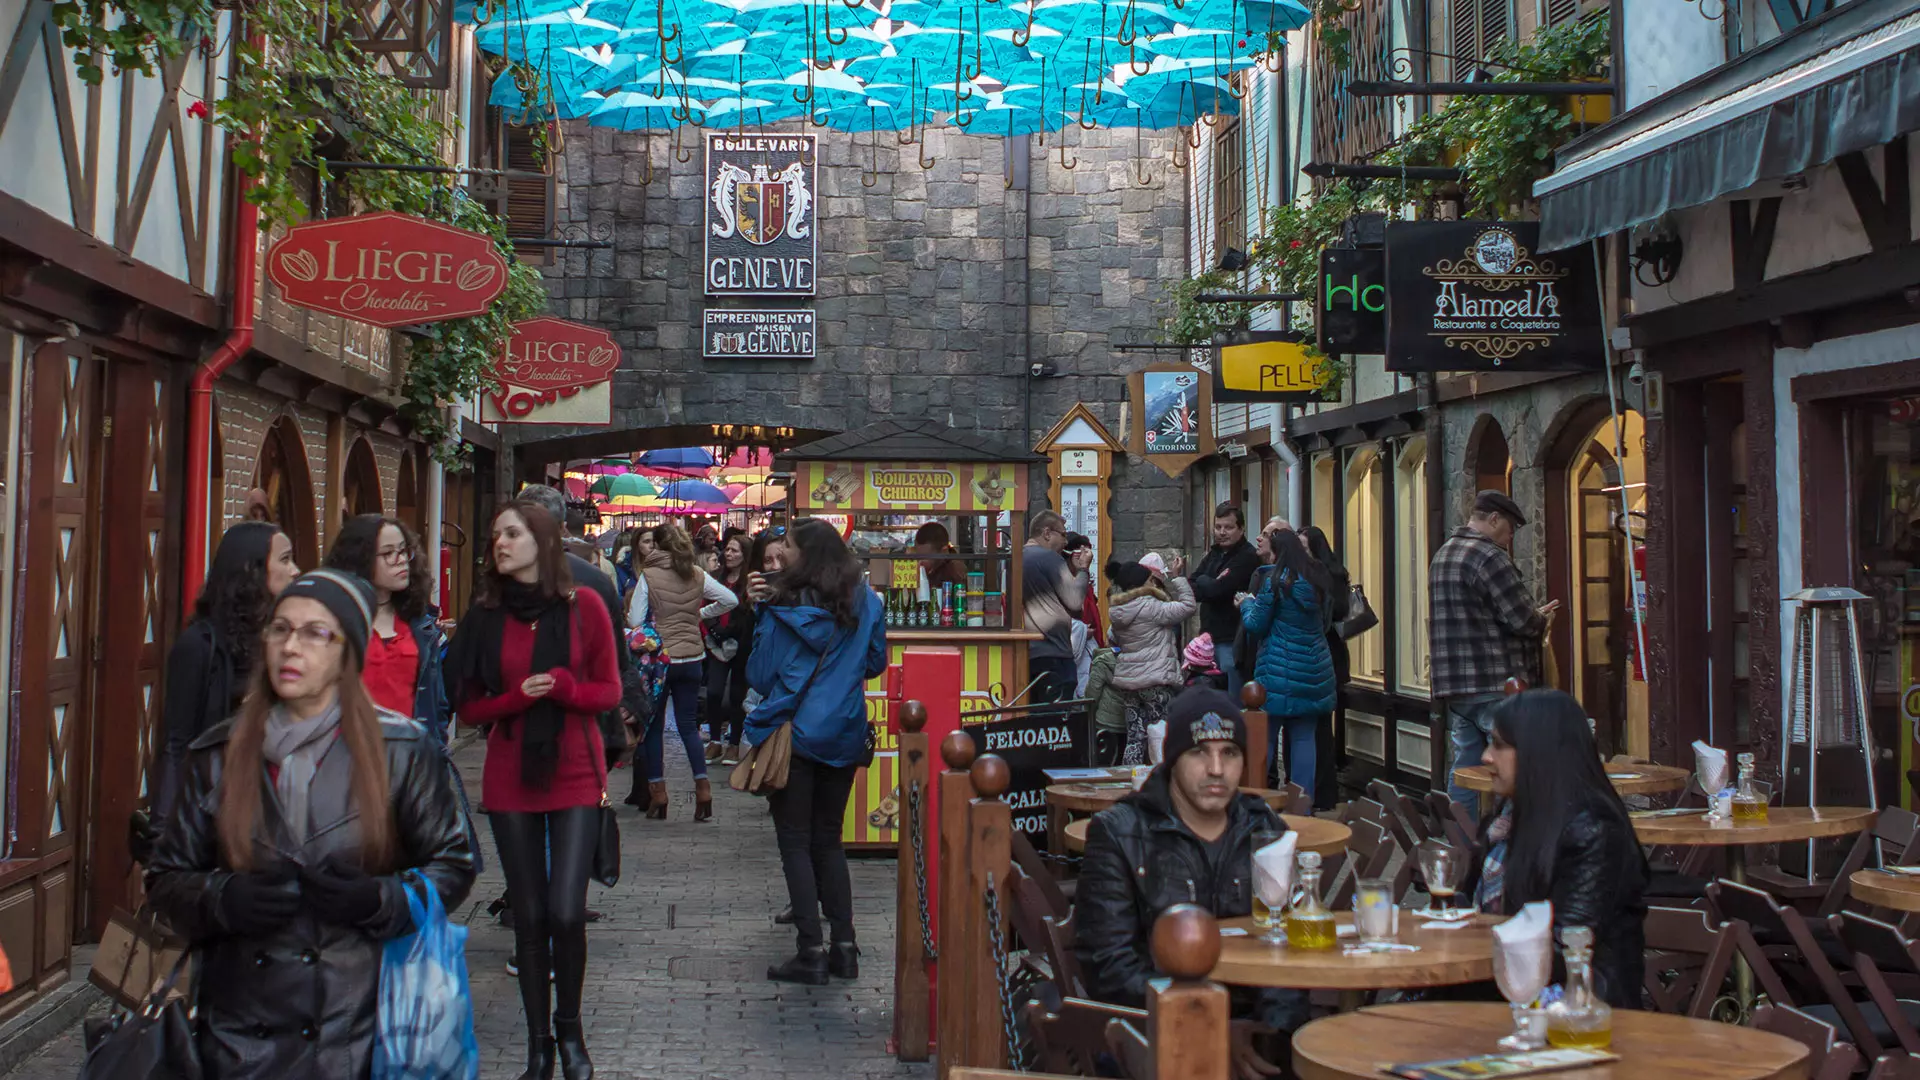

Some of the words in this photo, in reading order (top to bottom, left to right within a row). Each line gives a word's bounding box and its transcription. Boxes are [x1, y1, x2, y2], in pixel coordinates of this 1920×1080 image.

[714, 139, 810, 152] BOULEVARD
[323, 240, 453, 284] LIÉGE
[710, 257, 812, 289] GENEVE
[341, 282, 433, 312] Chocolates
[707, 313, 812, 323] EMPREENDIMENTO
[1433, 318, 1487, 329] Restaurante
[1490, 321, 1497, 329] e
[1501, 318, 1560, 332] Coquetelaria
[755, 324, 792, 332] MAISON
[503, 337, 586, 363] LIÉGE
[747, 331, 812, 353] GENEVE
[515, 363, 574, 382] Chocolates
[1147, 443, 1197, 451] VICTORINOX
[873, 472, 953, 487] BOULEVARD
[881, 486, 945, 500] CHURROS
[985, 726, 1071, 750] FEIJOADA
